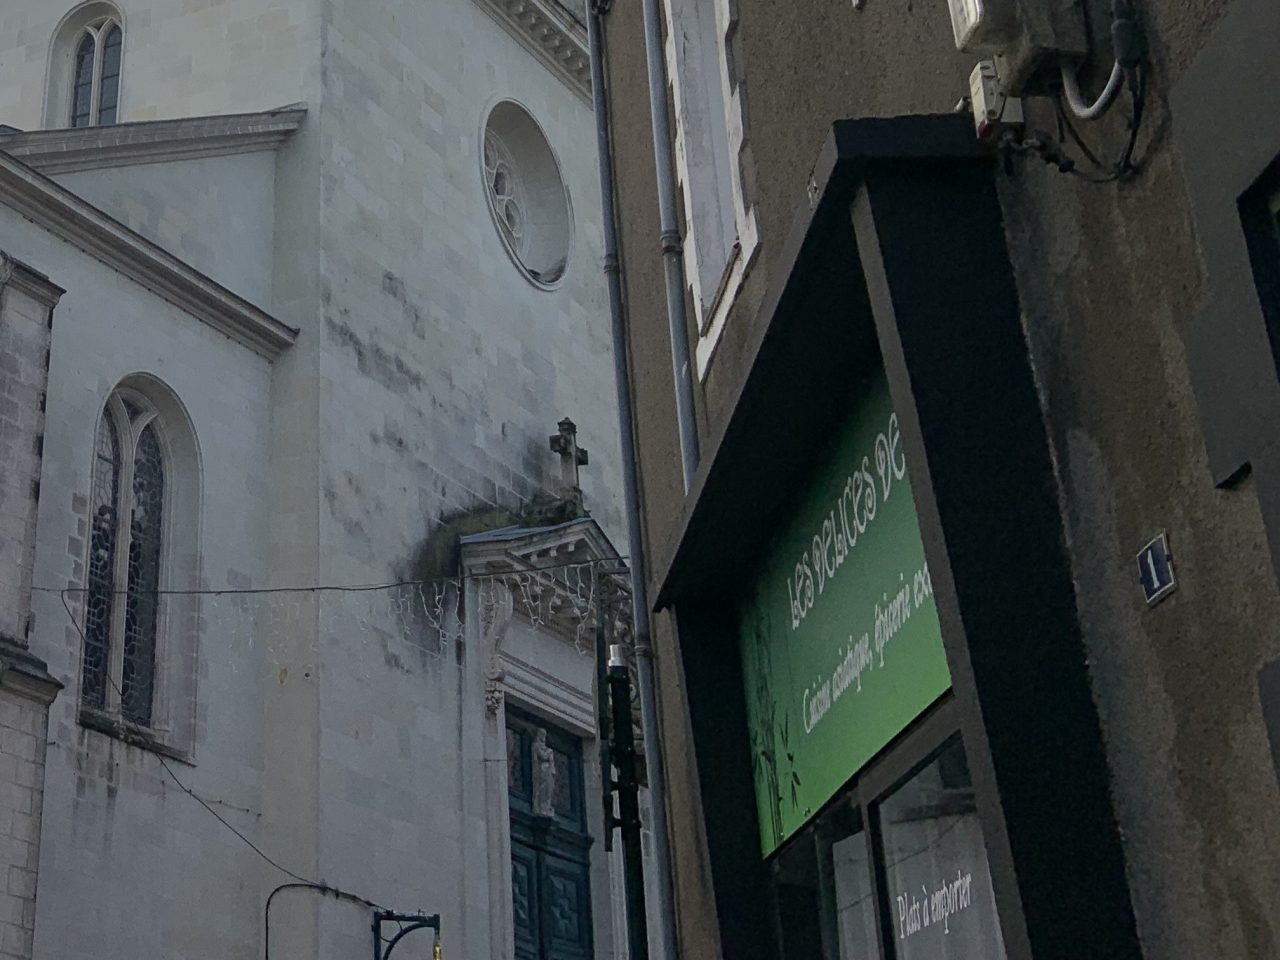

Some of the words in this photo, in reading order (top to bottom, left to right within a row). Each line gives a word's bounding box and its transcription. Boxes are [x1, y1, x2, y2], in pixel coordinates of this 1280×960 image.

[786, 551, 815, 631] LES
[812, 455, 877, 595] DELICES
[875, 411, 906, 503] DE
[1147, 548, 1161, 589] 1
[802, 674, 832, 734] Cuisine
[874, 572, 911, 668] épicerie
[896, 891, 921, 939] Plats
[922, 884, 930, 928] à
[930, 869, 972, 935] emporter
